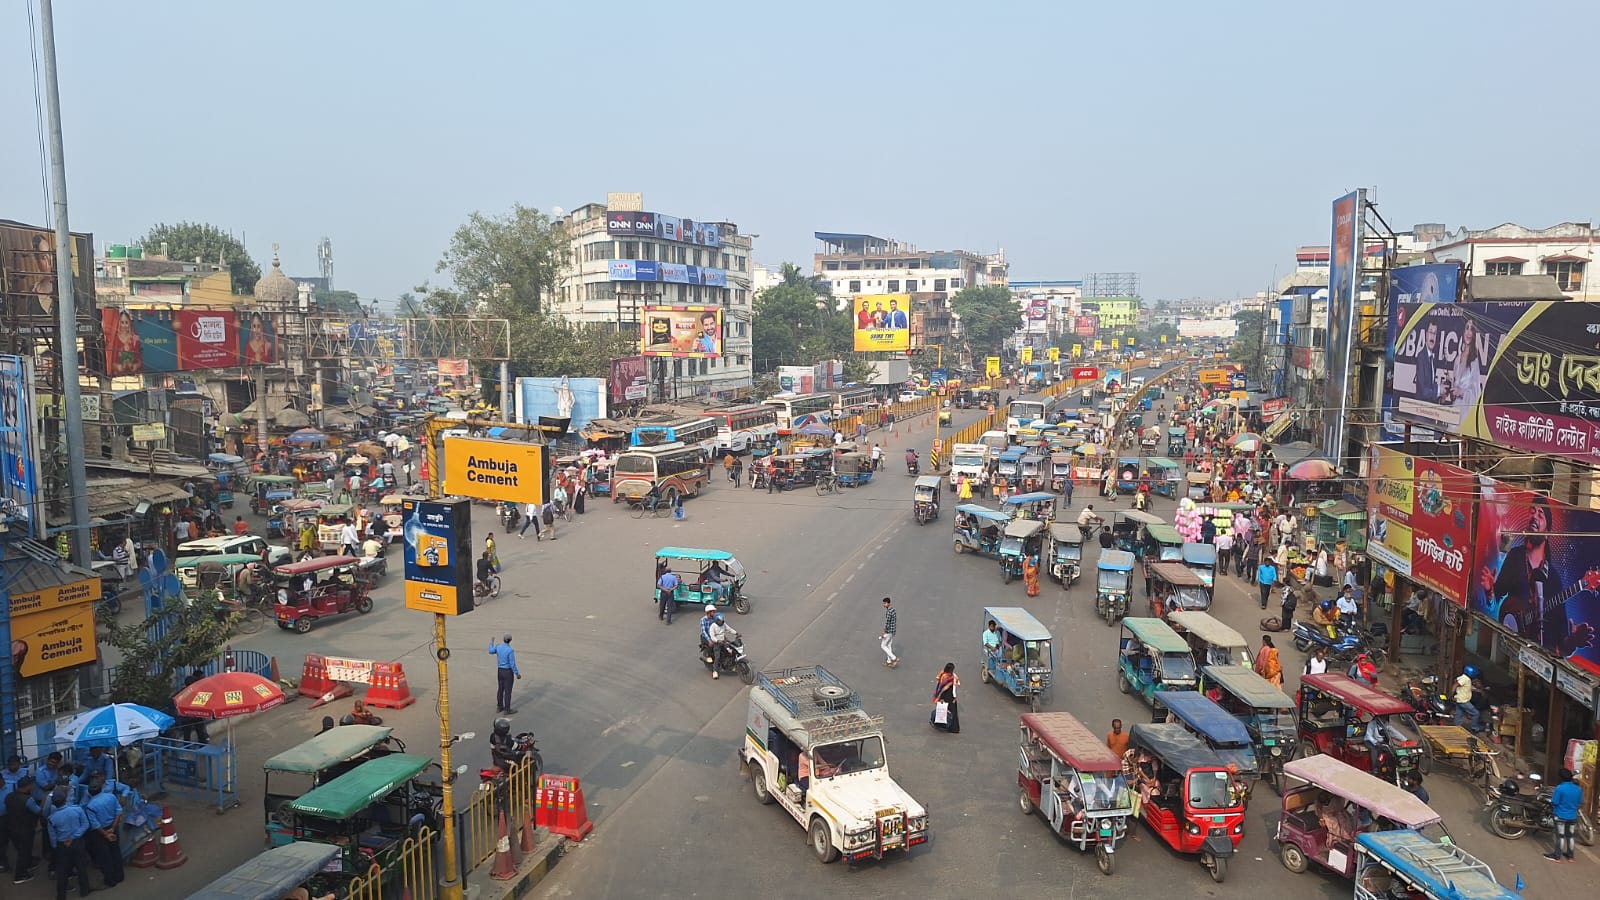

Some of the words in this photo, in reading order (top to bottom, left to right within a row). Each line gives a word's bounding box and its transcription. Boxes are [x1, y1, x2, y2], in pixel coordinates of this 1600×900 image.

[609, 220, 631, 229] ONN
[635, 221, 654, 230] ONN
[1439, 331, 1490, 367] ICN
[1517, 351, 1552, 388] ডাঃ
[1557, 422, 1587, 450] সেন্টার
[467, 455, 518, 474] Ambuja
[467, 470, 518, 487] Cement
[1415, 536, 1444, 564] শাড়ির
[57, 591, 91, 602] Cement
[58, 585, 90, 596] Ambuja
[41, 637, 82, 652] Ambuja
[41, 645, 83, 660] Cement
